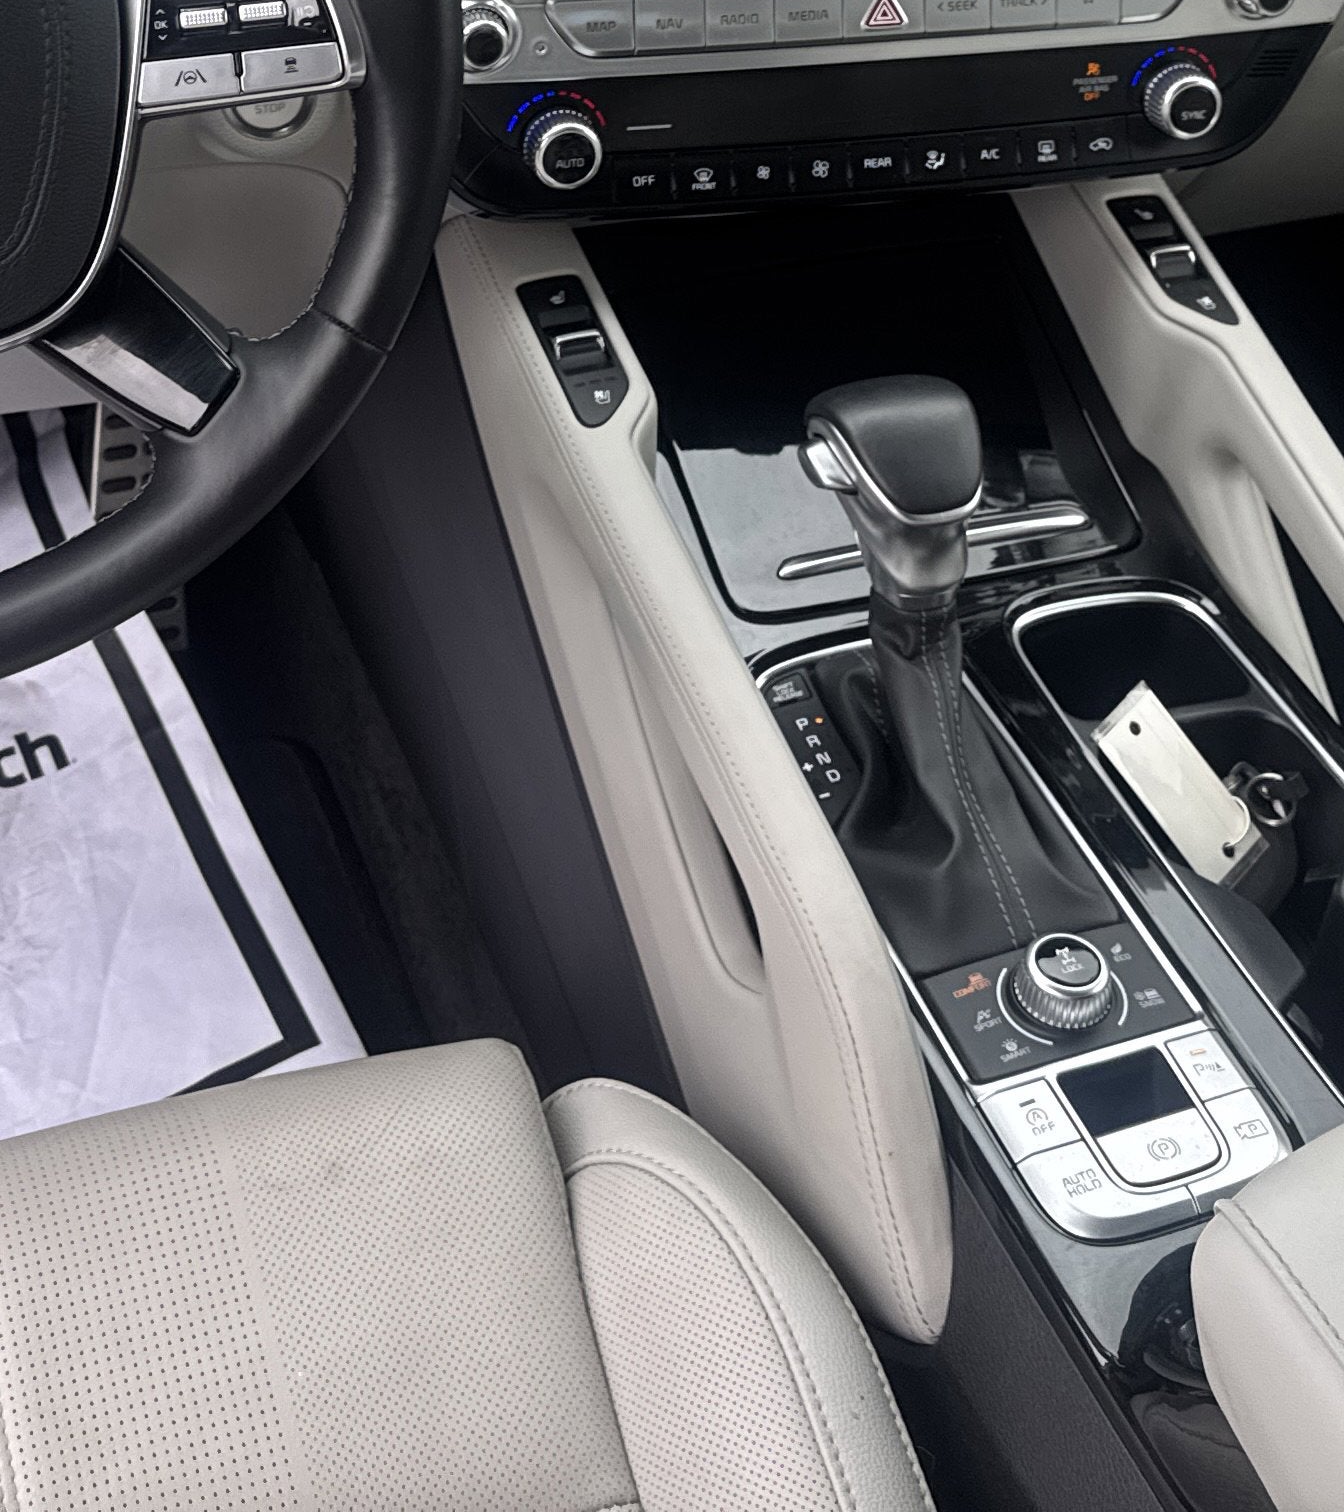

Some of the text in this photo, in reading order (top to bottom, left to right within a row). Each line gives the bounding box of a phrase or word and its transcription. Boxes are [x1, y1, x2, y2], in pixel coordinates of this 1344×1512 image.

[948, 0, 979, 12] SEEK
[719, 13, 760, 27] RADIO
[787, 8, 829, 22] MEDIA
[154, 20, 169, 30] OK
[586, 20, 617, 34] MAP
[656, 17, 684, 30] NAV
[255, 102, 286, 114] STOP
[1180, 109, 1208, 121] SYNC
[980, 148, 1001, 161] A/C
[1037, 153, 1058, 163] REAR
[555, 157, 586, 169] AUTO
[863, 156, 893, 169] REAR
[632, 174, 656, 188] OFF
[691, 180, 717, 191] FRONT
[795, 717, 809, 731] P
[805, 734, 822, 748] R
[815, 751, 832, 766] N
[825, 768, 841, 783] D
[1113, 952, 1133, 963] ECO
[1060, 962, 1085, 974] LOCK
[952, 978, 993, 999] COMFORT
[973, 1015, 1004, 1033] SPORT
[999, 1045, 1032, 1063] SMART
[1031, 1121, 1056, 1137] OFF
[1061, 1167, 1098, 1189] AUTO
[1066, 1178, 1104, 1199] HOLD
